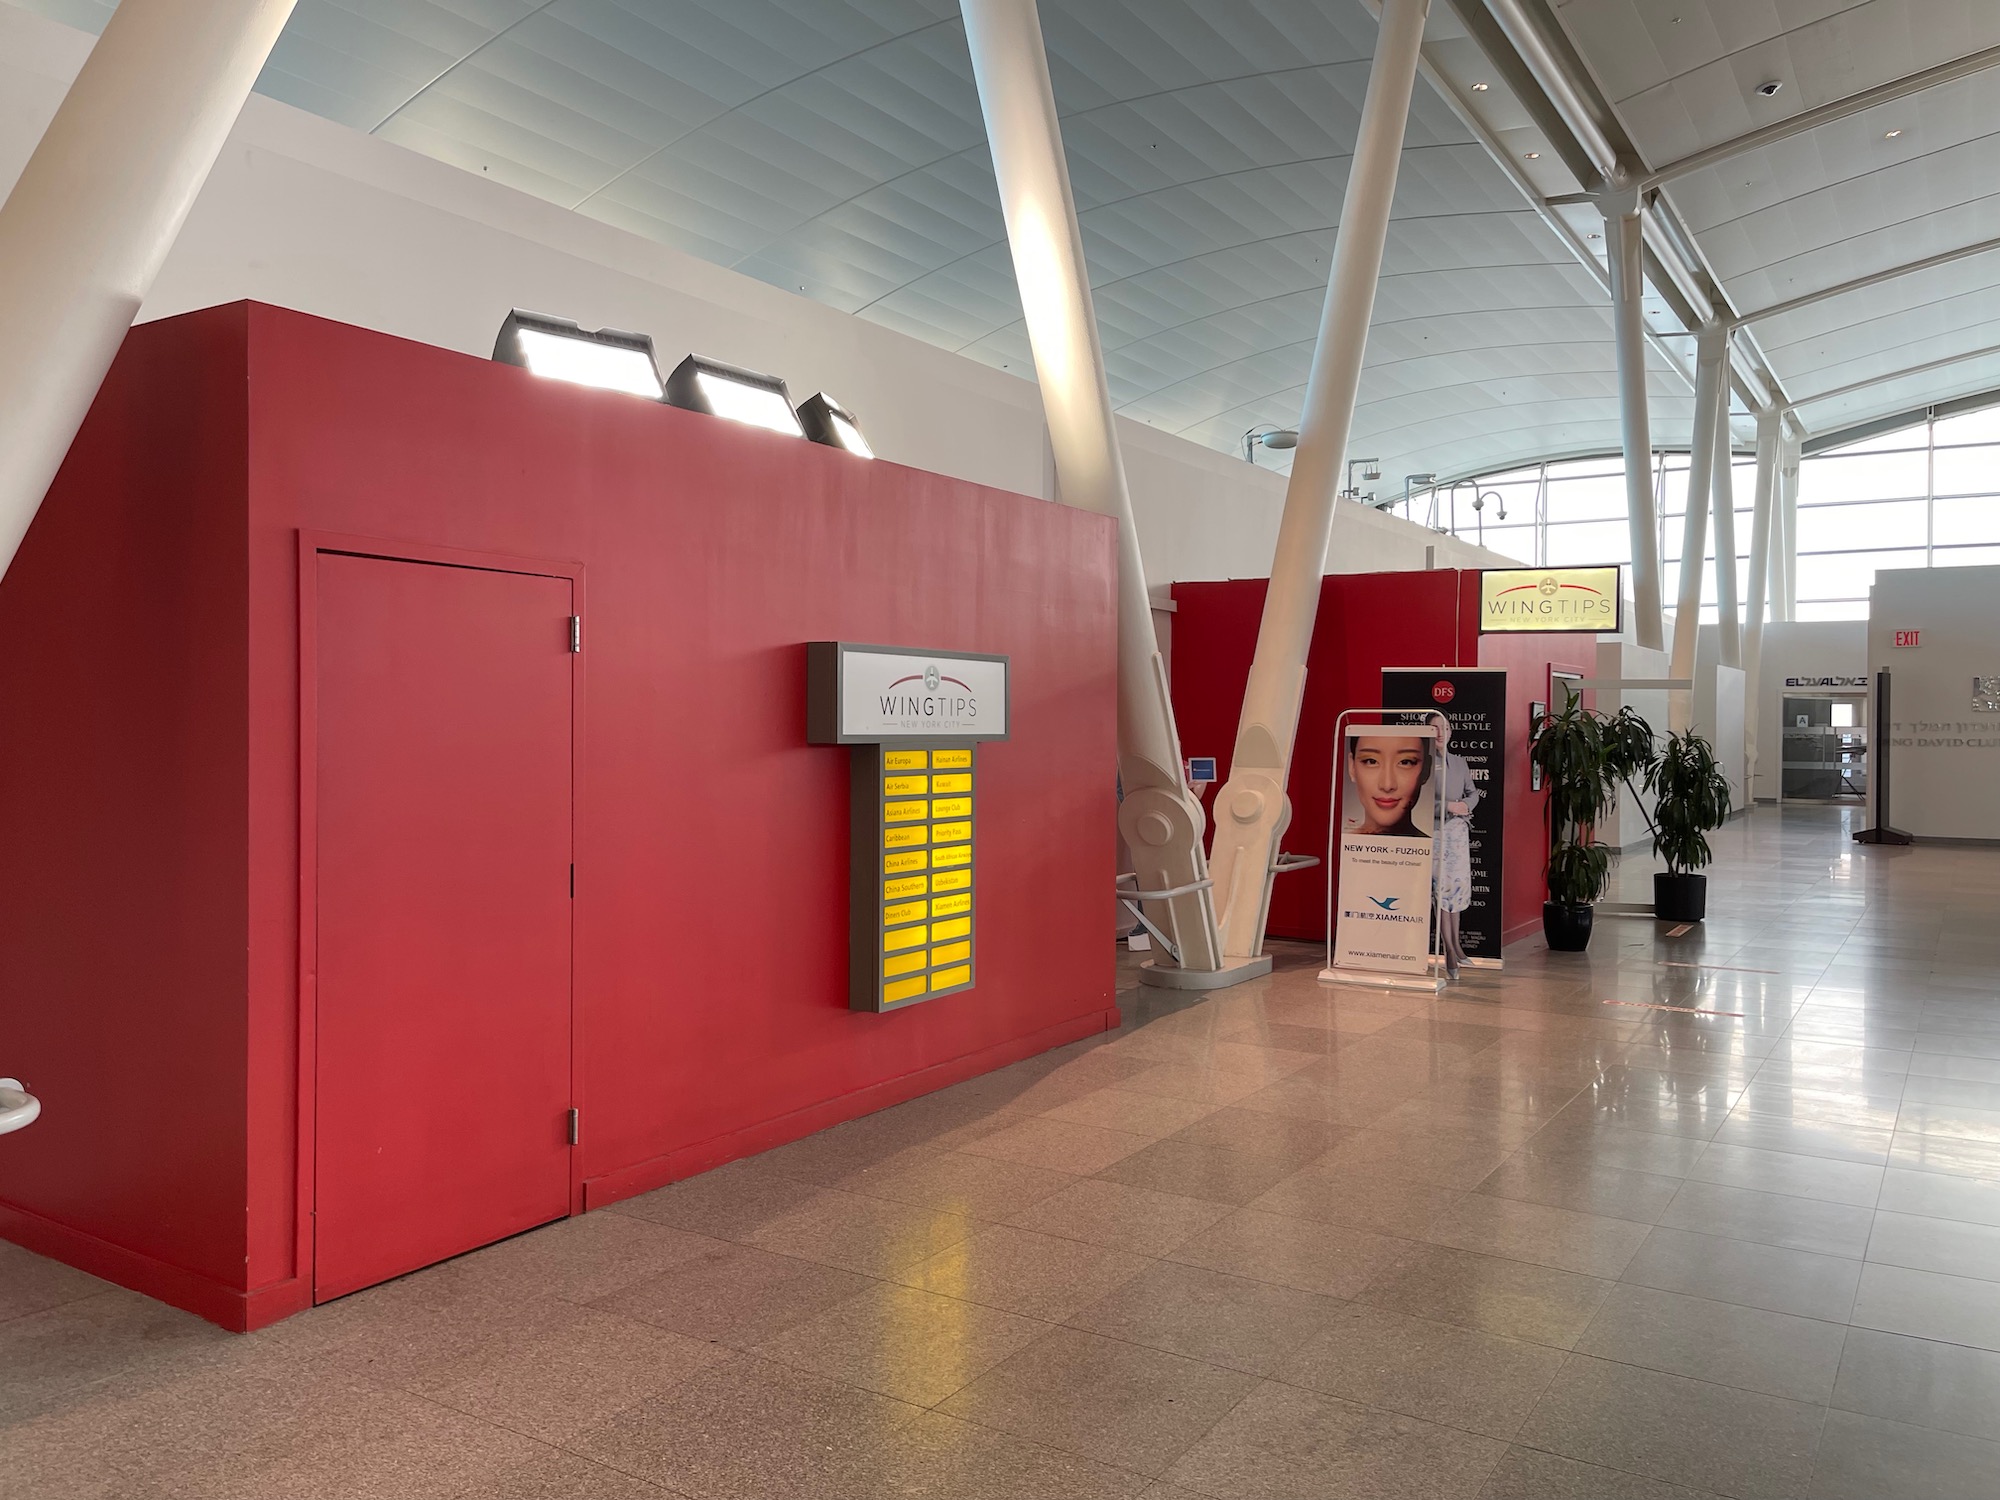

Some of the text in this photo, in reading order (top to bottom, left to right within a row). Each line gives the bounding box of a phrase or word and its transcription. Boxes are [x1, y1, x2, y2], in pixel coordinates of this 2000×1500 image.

[1488, 599, 1611, 615] WINGTIPS
[1895, 630, 1920, 646] EXIT
[1433, 687, 1454, 697] DFS
[879, 695, 977, 717] WINGTIPS
[1473, 713, 1487, 722] OF
[900, 720, 961, 728] NEW YORK CITY
[1461, 722, 1491, 731] STYLE
[1450, 740, 1494, 749] GUCCI
[1917, 738, 1964, 747] DAVID
[886, 757, 911, 766] Air Europa
[894, 782, 909, 790] Serbia
[886, 807, 920, 816] Asiana Airlines
[886, 834, 910, 842] Caribbean
[1344, 844, 1364, 852] NEW
[1365, 845, 1389, 854] YORK
[1395, 847, 1431, 856] FUZHOU
[886, 858, 918, 868] China Airlines
[886, 882, 924, 894] China Southern
[1472, 885, 1490, 893] ARTIN
[935, 898, 970, 911] Xiamen Airlines
[886, 909, 911, 920] Diners Club
[1375, 913, 1424, 924] XIAMENAIR
[1348, 950, 1416, 961] www.xiamenair.com
